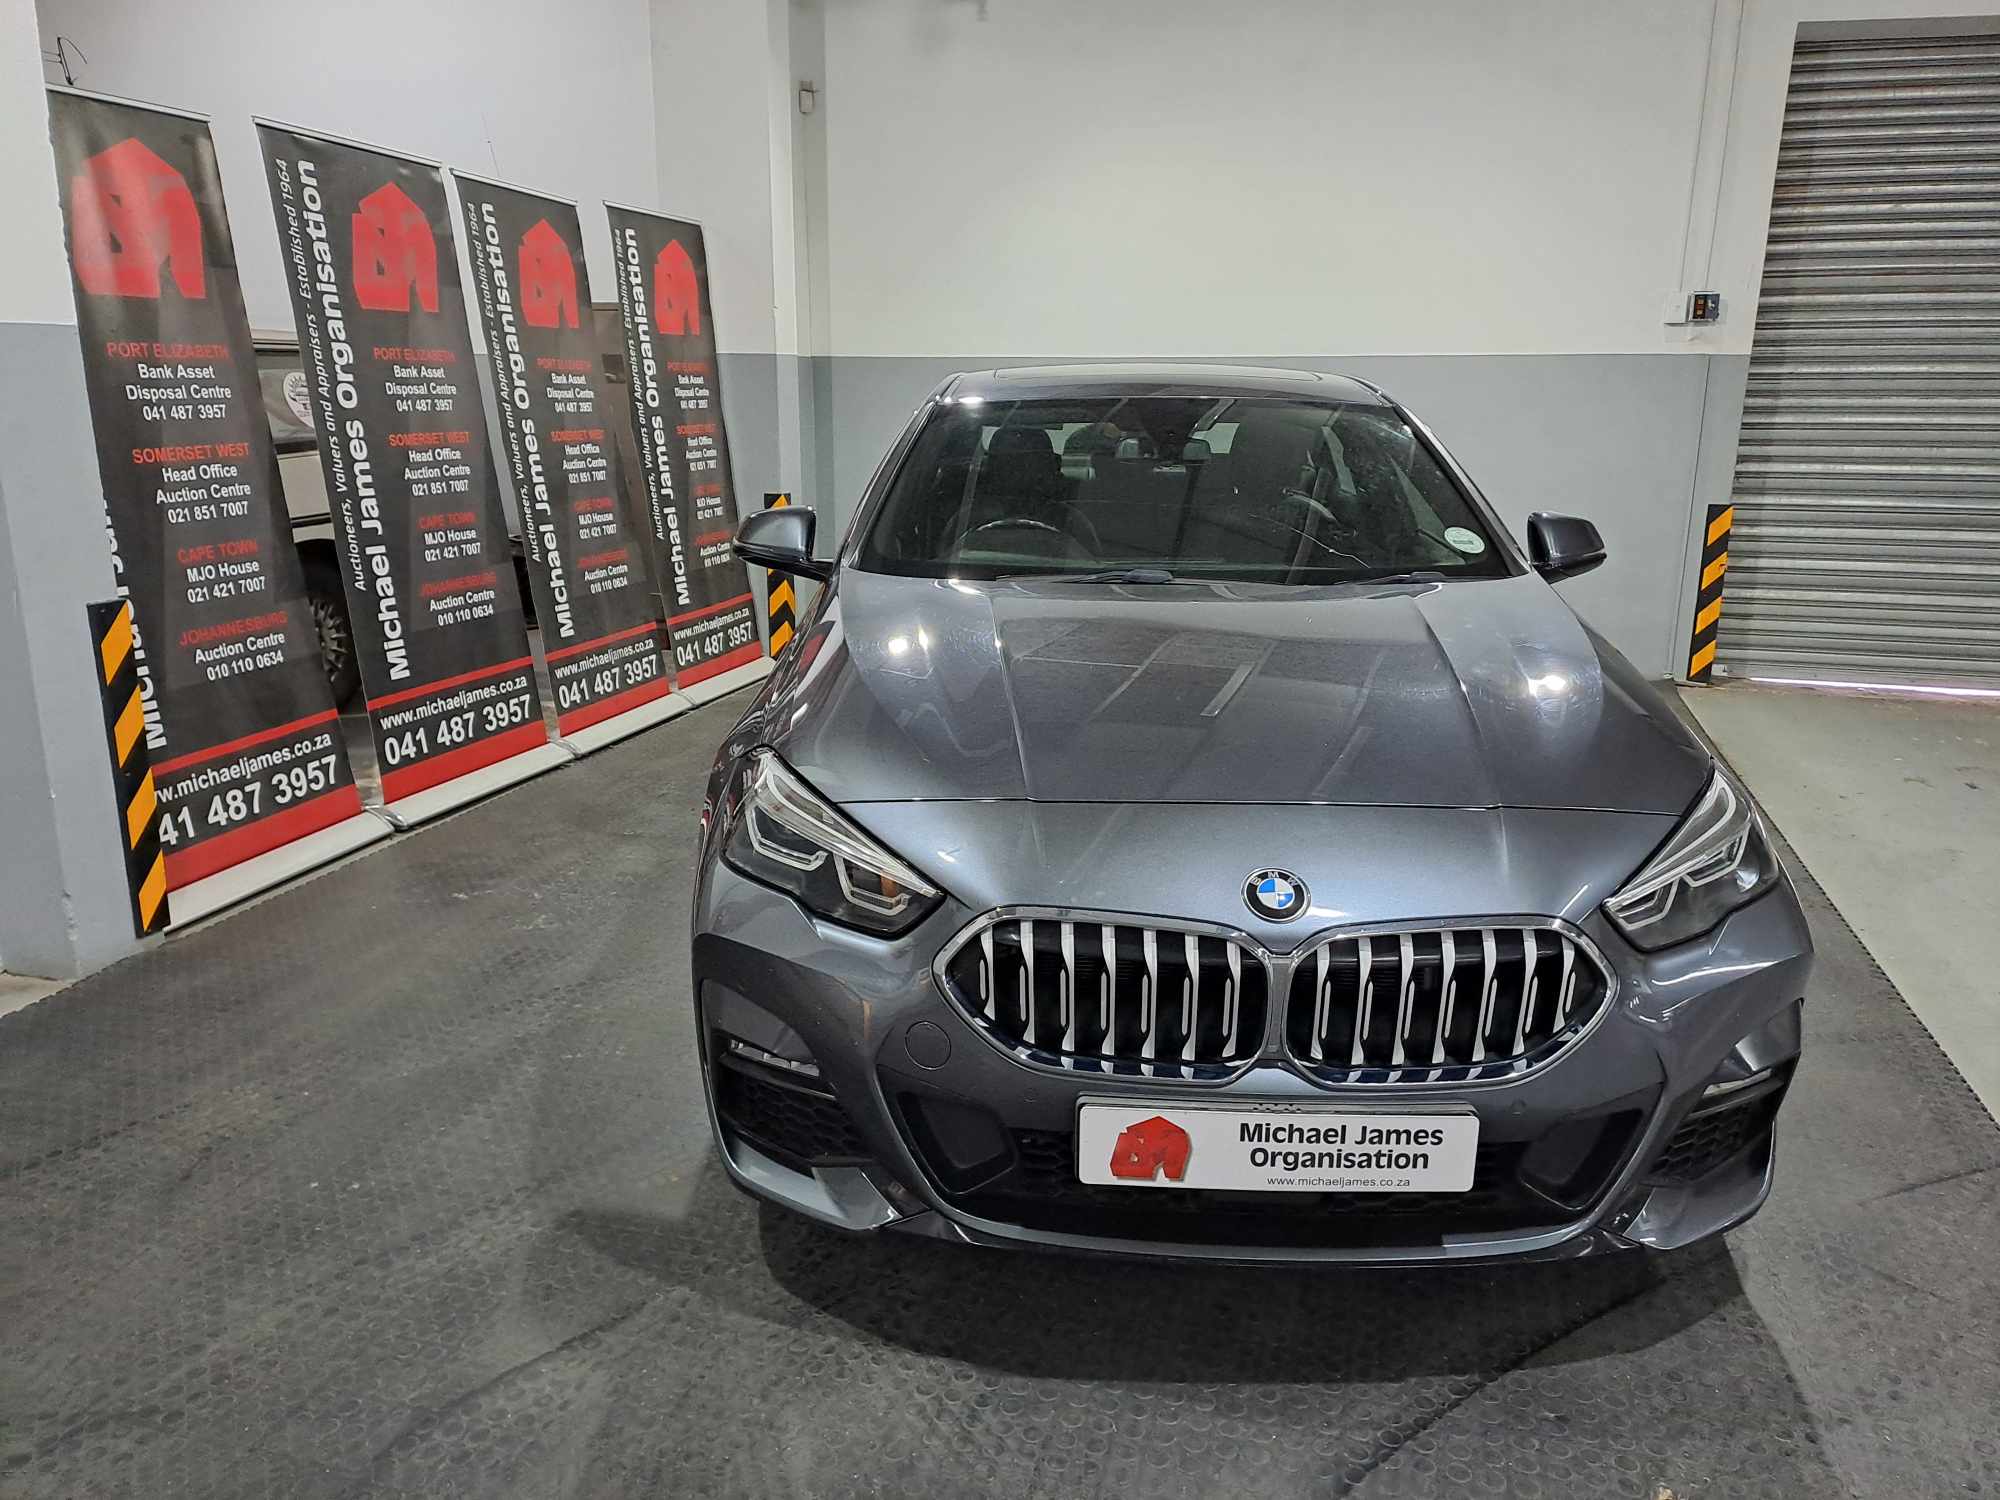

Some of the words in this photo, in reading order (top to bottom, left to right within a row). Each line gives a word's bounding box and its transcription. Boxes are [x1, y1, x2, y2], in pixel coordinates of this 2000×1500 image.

[276, 158, 293, 200] 1964
[283, 204, 312, 299] Established
[298, 160, 358, 409] Organisation
[481, 203, 530, 409] Organisation
[625, 228, 659, 407] Organisation
[107, 343, 149, 359] PORT
[306, 313, 331, 397] Appraisers
[491, 329, 509, 400] Appraisers
[138, 363, 174, 379] Bank
[177, 364, 215, 378] Asset
[393, 365, 418, 378] Bank
[421, 366, 445, 378] Asset
[628, 339, 642, 400] Appraisers
[126, 384, 187, 403] Disposal
[190, 384, 231, 399] Centre
[385, 382, 427, 397] Disposal
[430, 383, 457, 395] Centre
[143, 407, 166, 421] 041
[171, 405, 193, 420] 487
[199, 404, 226, 418] 3957
[320, 400, 336, 432] and
[396, 400, 412, 412] 041
[416, 399, 432, 412] 487
[435, 399, 453, 411] 3957
[502, 402, 515, 428] and
[635, 402, 646, 424] and
[132, 444, 213, 463] SOMERSET
[216, 442, 249, 457] WEST
[408, 450, 433, 463] Head
[435, 448, 461, 460] Office
[510, 432, 525, 479] Valuers
[641, 427, 653, 468] Valuers
[651, 416, 673, 500] James
[162, 466, 196, 482] Head
[200, 463, 238, 479] Office
[329, 435, 347, 492] Valuers
[345, 420, 383, 536] James
[405, 467, 440, 480] Auction
[443, 465, 470, 476] Centre
[522, 419, 551, 516] James
[156, 486, 207, 504] Auction
[211, 483, 250, 499] Centre
[412, 483, 428, 496] 021
[431, 481, 446, 494] 851
[449, 480, 468, 492] 7007
[168, 507, 190, 523] 021
[194, 504, 216, 520] 851
[220, 501, 248, 517] 7007
[648, 473, 664, 540] Auctioneers,
[424, 532, 445, 545] MJO
[447, 529, 476, 541] House
[520, 485, 541, 562] Auctioneers,
[177, 543, 214, 563] CAPE
[219, 538, 258, 556] TOWN
[341, 499, 366, 591] Auctioneers,
[425, 550, 440, 562] 021
[443, 547, 459, 560] 421
[461, 543, 481, 555] 7007
[663, 507, 690, 605] Michael
[187, 566, 215, 583] MJO
[219, 560, 260, 577] House
[539, 524, 575, 638] Michael
[585, 568, 607, 581] Auction
[187, 588, 209, 604] 021
[213, 582, 235, 599] 421
[239, 576, 265, 593] 7007
[430, 595, 464, 612] Auction
[466, 589, 495, 604] Centre
[365, 545, 411, 680] Michael
[438, 613, 454, 626] 010
[456, 609, 470, 623] 110
[473, 604, 494, 618] 0634
[195, 642, 244, 664] Auction
[247, 631, 285, 651] Centre
[555, 638, 654, 679] www.michaeljames.co.za
[676, 640, 701, 666] 041
[704, 632, 724, 656] 487
[727, 621, 752, 647] 3957
[207, 664, 229, 681] 010
[232, 657, 253, 674] 110
[257, 650, 284, 668] 0634
[559, 678, 589, 708] 041
[594, 667, 620, 695] 487
[624, 654, 657, 684] 3957
[380, 676, 527, 730] www.michaeljames.co.za
[384, 727, 428, 765] 041
[437, 712, 475, 746] 487
[483, 694, 530, 731] 3957
[207, 781, 261, 826] 487
[271, 754, 337, 804] 3957
[1249, 871, 1299, 886] BMW
[1239, 1122, 1346, 1145] Michael
[1354, 1124, 1444, 1146] James
[1249, 1146, 1430, 1171] Organisation
[1266, 1176, 1410, 1188] www.michaeljames.co.za
